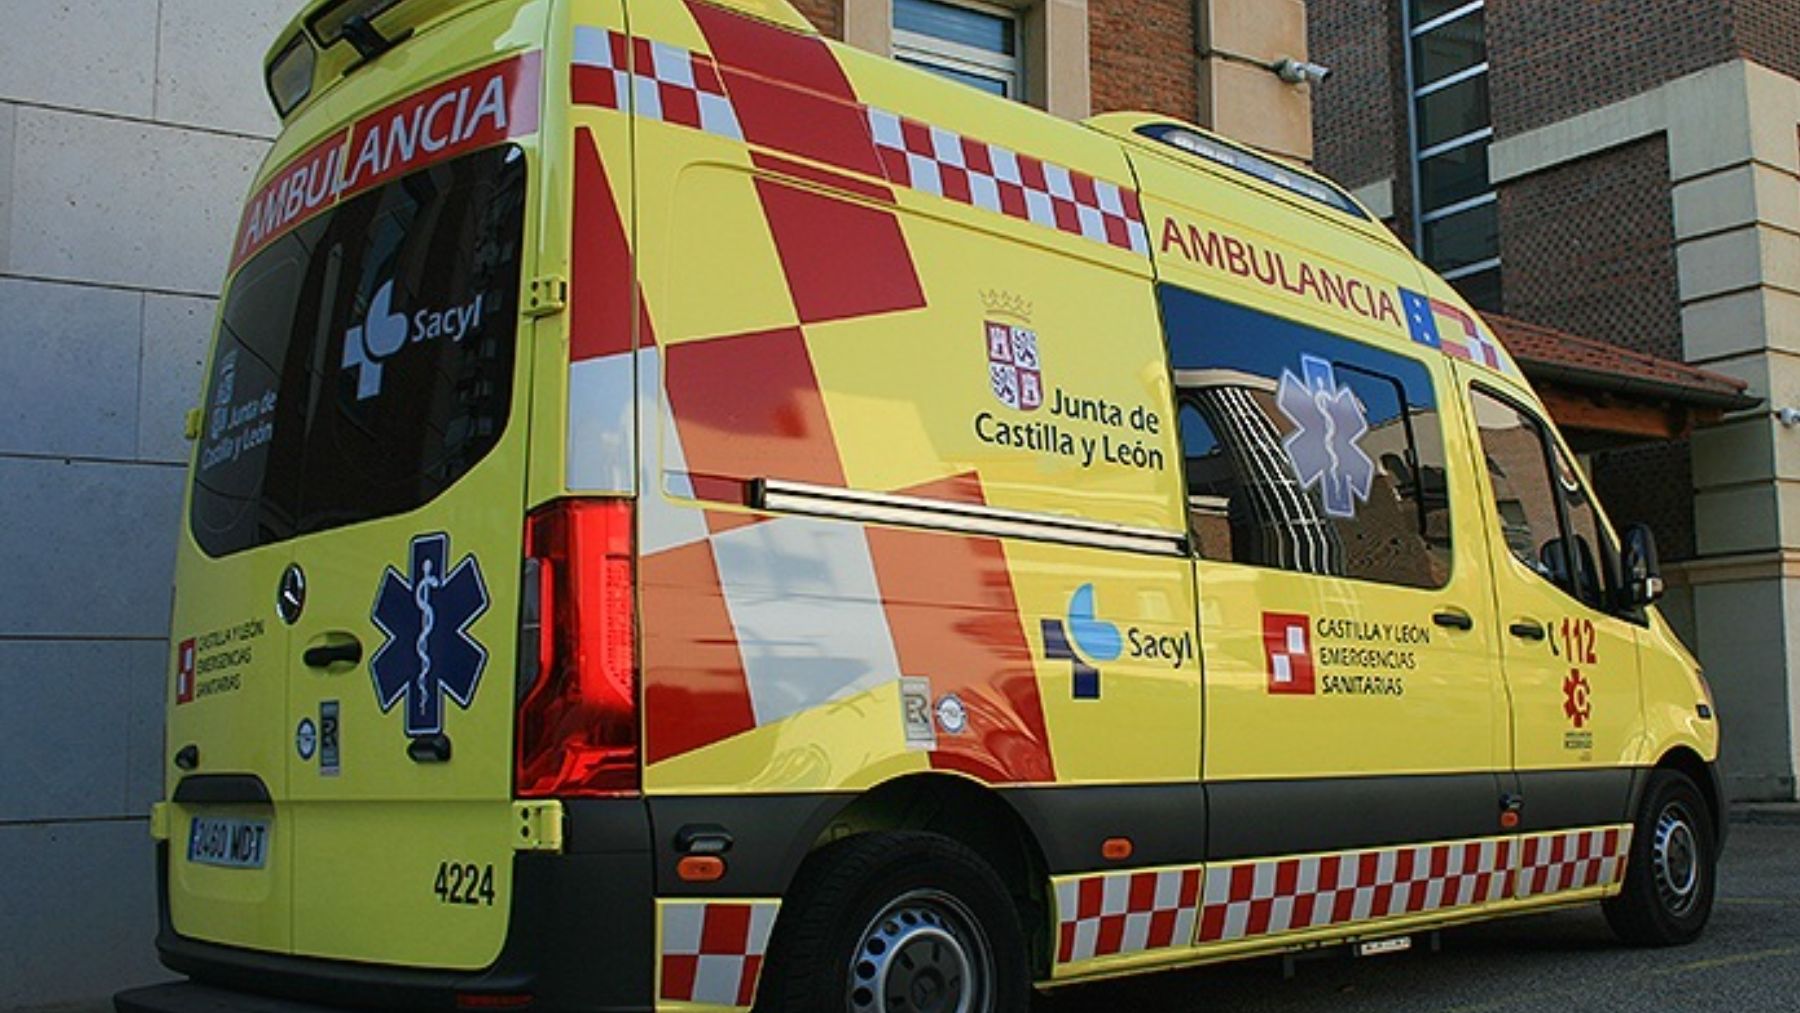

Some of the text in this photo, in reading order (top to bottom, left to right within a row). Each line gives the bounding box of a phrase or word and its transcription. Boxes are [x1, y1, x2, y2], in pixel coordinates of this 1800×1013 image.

[238, 74, 510, 256] AMBULANCIA
[1160, 216, 1402, 327] AMBULANCIA
[411, 293, 482, 342] Sacyl
[1050, 387, 1160, 435] Junta de
[975, 412, 1165, 471] Castilla y León
[1127, 626, 1192, 669] Sacyl
[1317, 617, 1382, 641] CASTILLA
[1384, 624, 1394, 641] Y
[1561, 616, 1597, 664] 112
[1319, 646, 1417, 670] EMERGENCIAS
[1321, 674, 1404, 696] SANITARIAS
[434, 861, 496, 907] 4224
